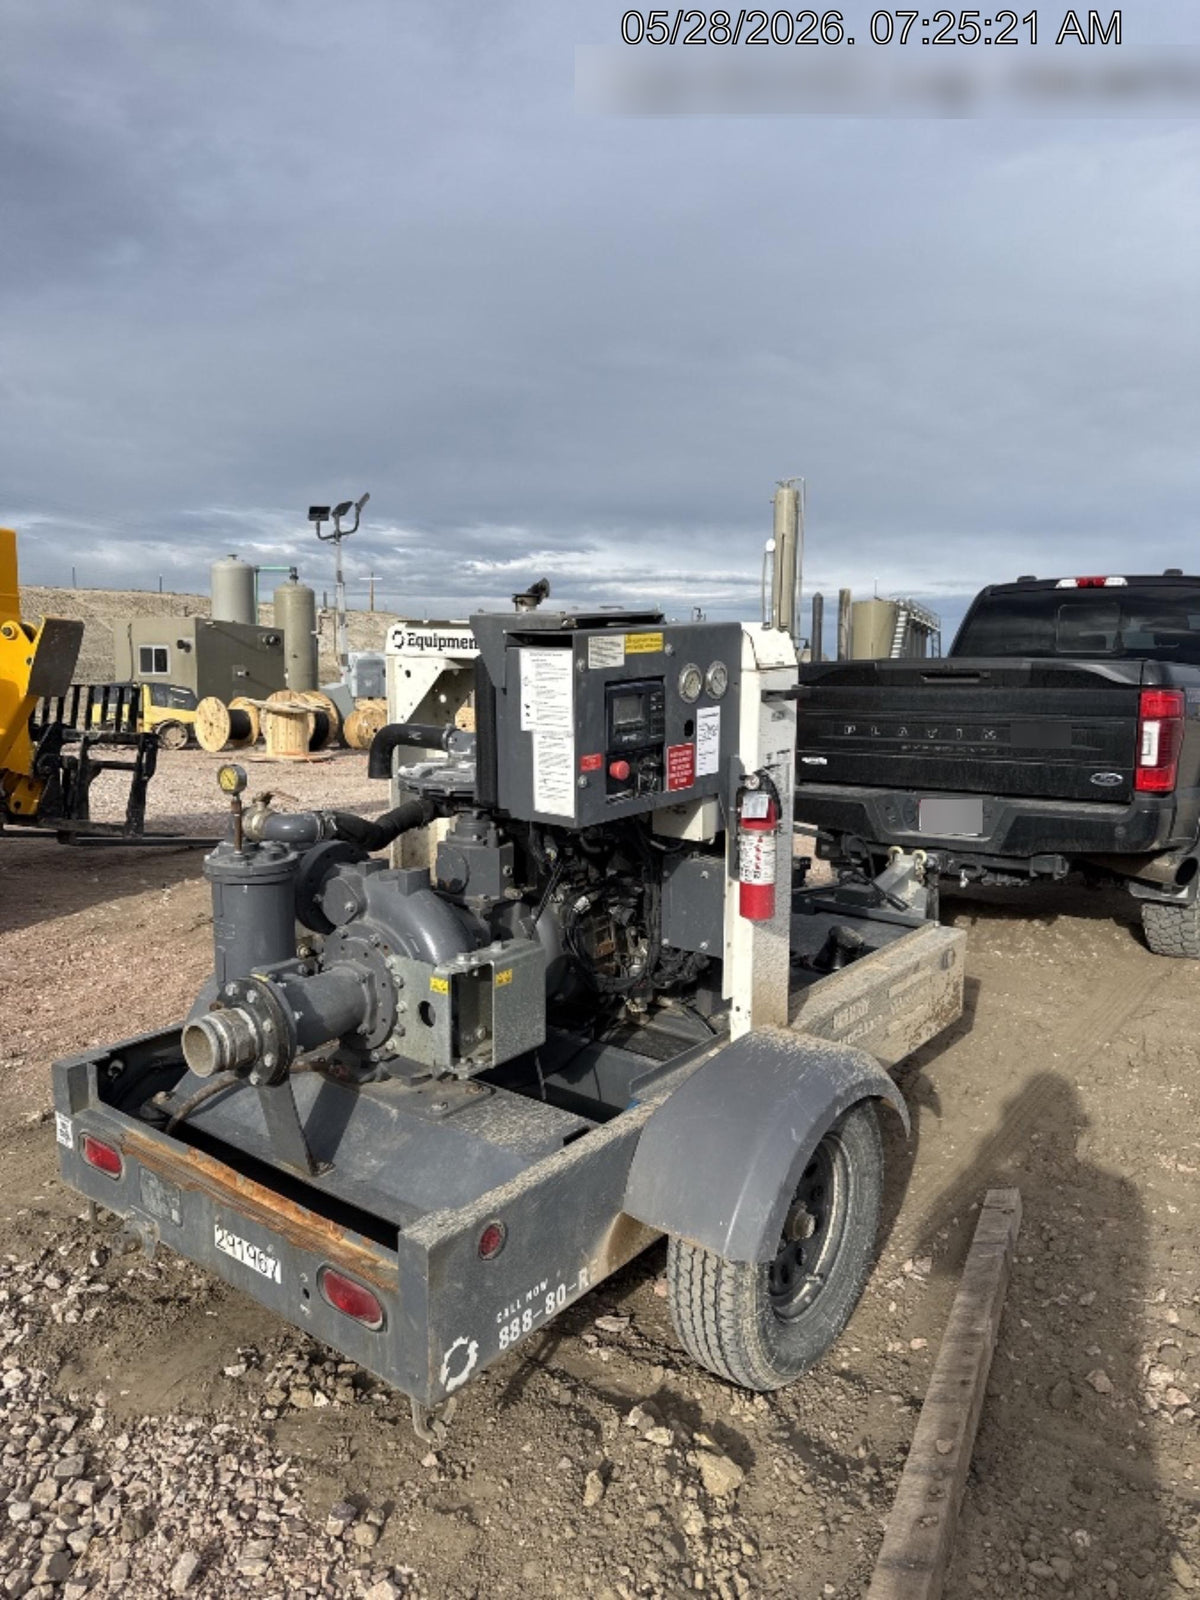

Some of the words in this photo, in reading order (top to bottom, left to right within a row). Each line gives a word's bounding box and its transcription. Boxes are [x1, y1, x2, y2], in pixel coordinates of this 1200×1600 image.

[407, 633, 478, 651] Equipmen
[497, 1299, 522, 1324] CALL
[526, 1278, 549, 1303] NOW
